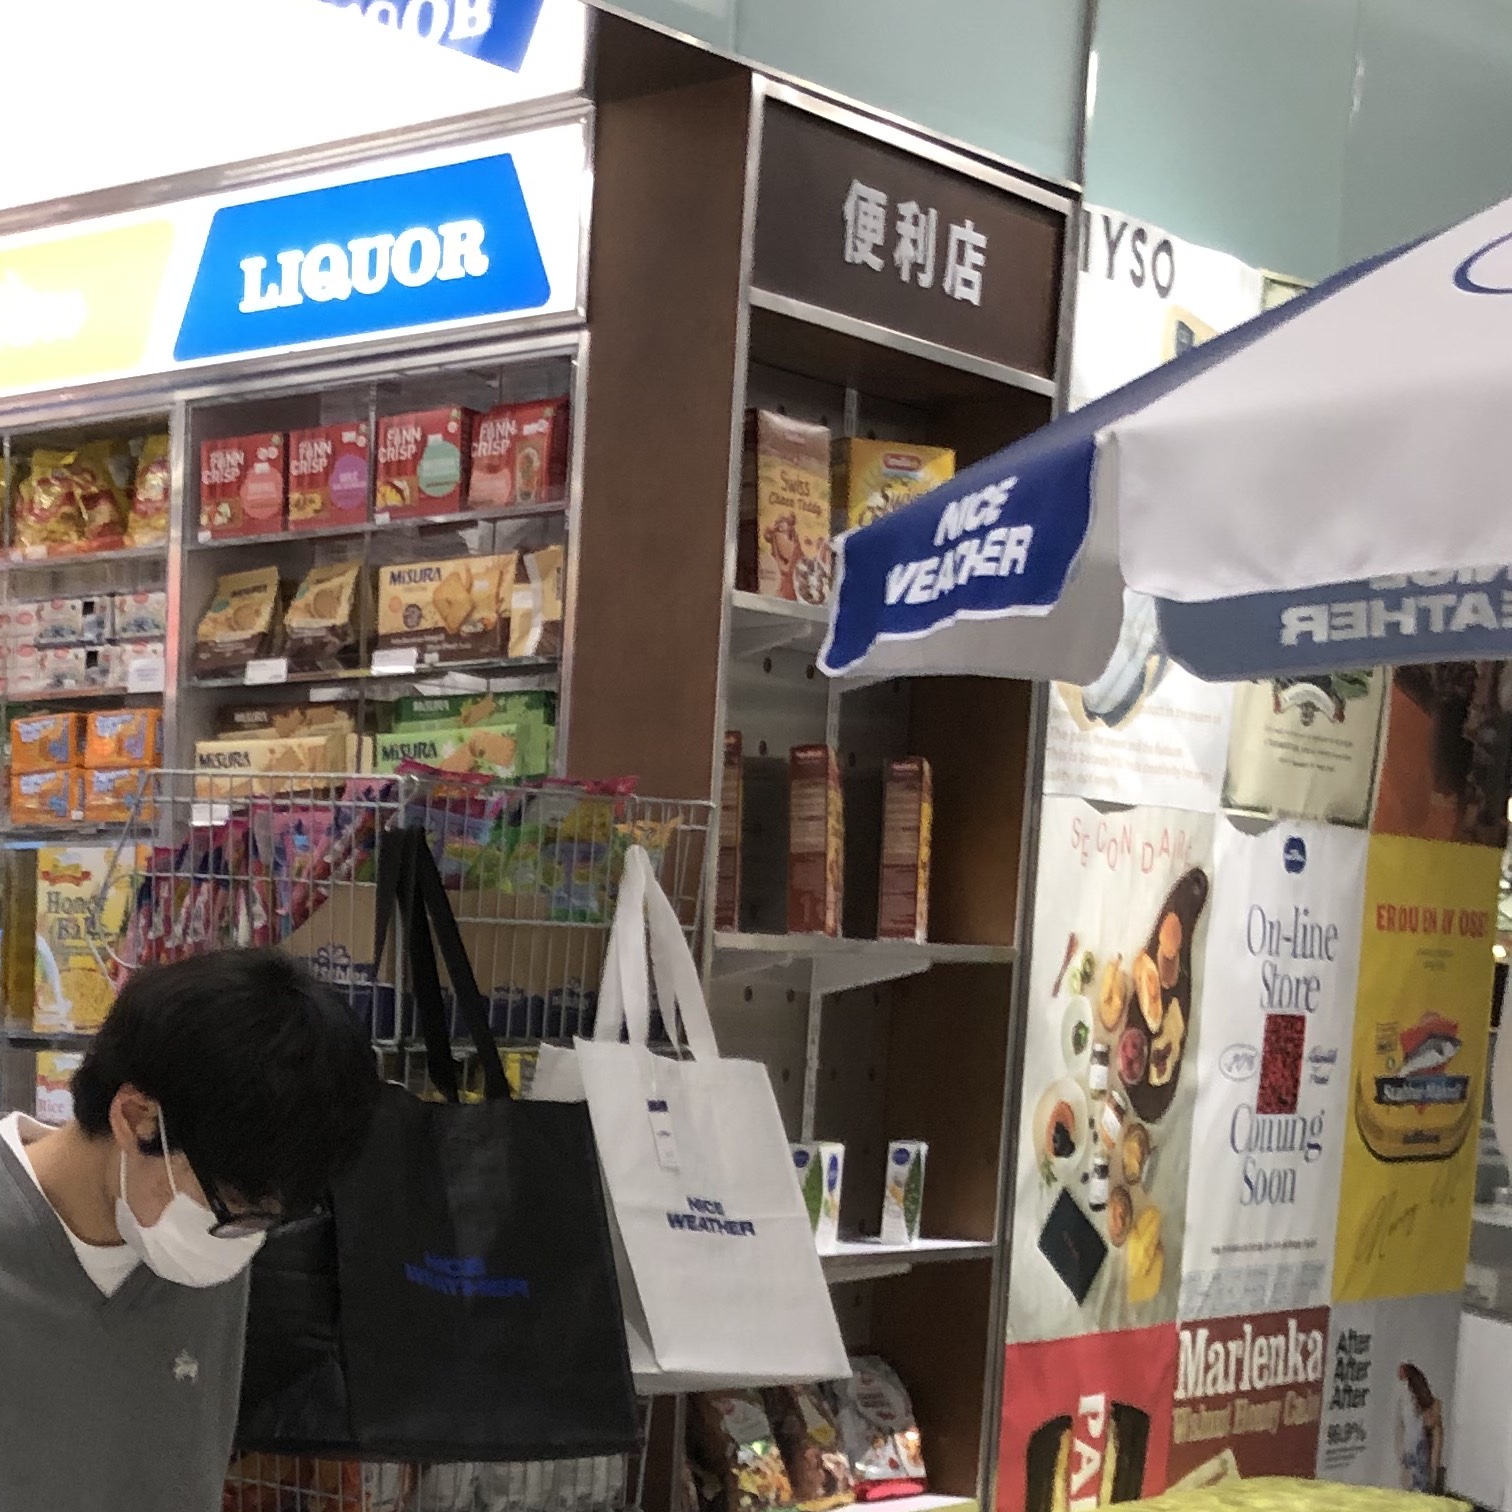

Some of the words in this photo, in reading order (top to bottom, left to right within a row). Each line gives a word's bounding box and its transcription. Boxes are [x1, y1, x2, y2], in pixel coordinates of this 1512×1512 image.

[238, 219, 489, 314] LIQUOR
[842, 178, 988, 307] 便利店
[933, 476, 1019, 546] NICE
[1246, 904, 1339, 962] On-line
[1260, 959, 1320, 1014] Store
[1230, 1103, 1325, 1162] Coming
[1240, 1159, 1296, 1207] Soon
[666, 1211, 756, 1236] WEATHER
[1173, 1317, 1325, 1400] Marlenka
